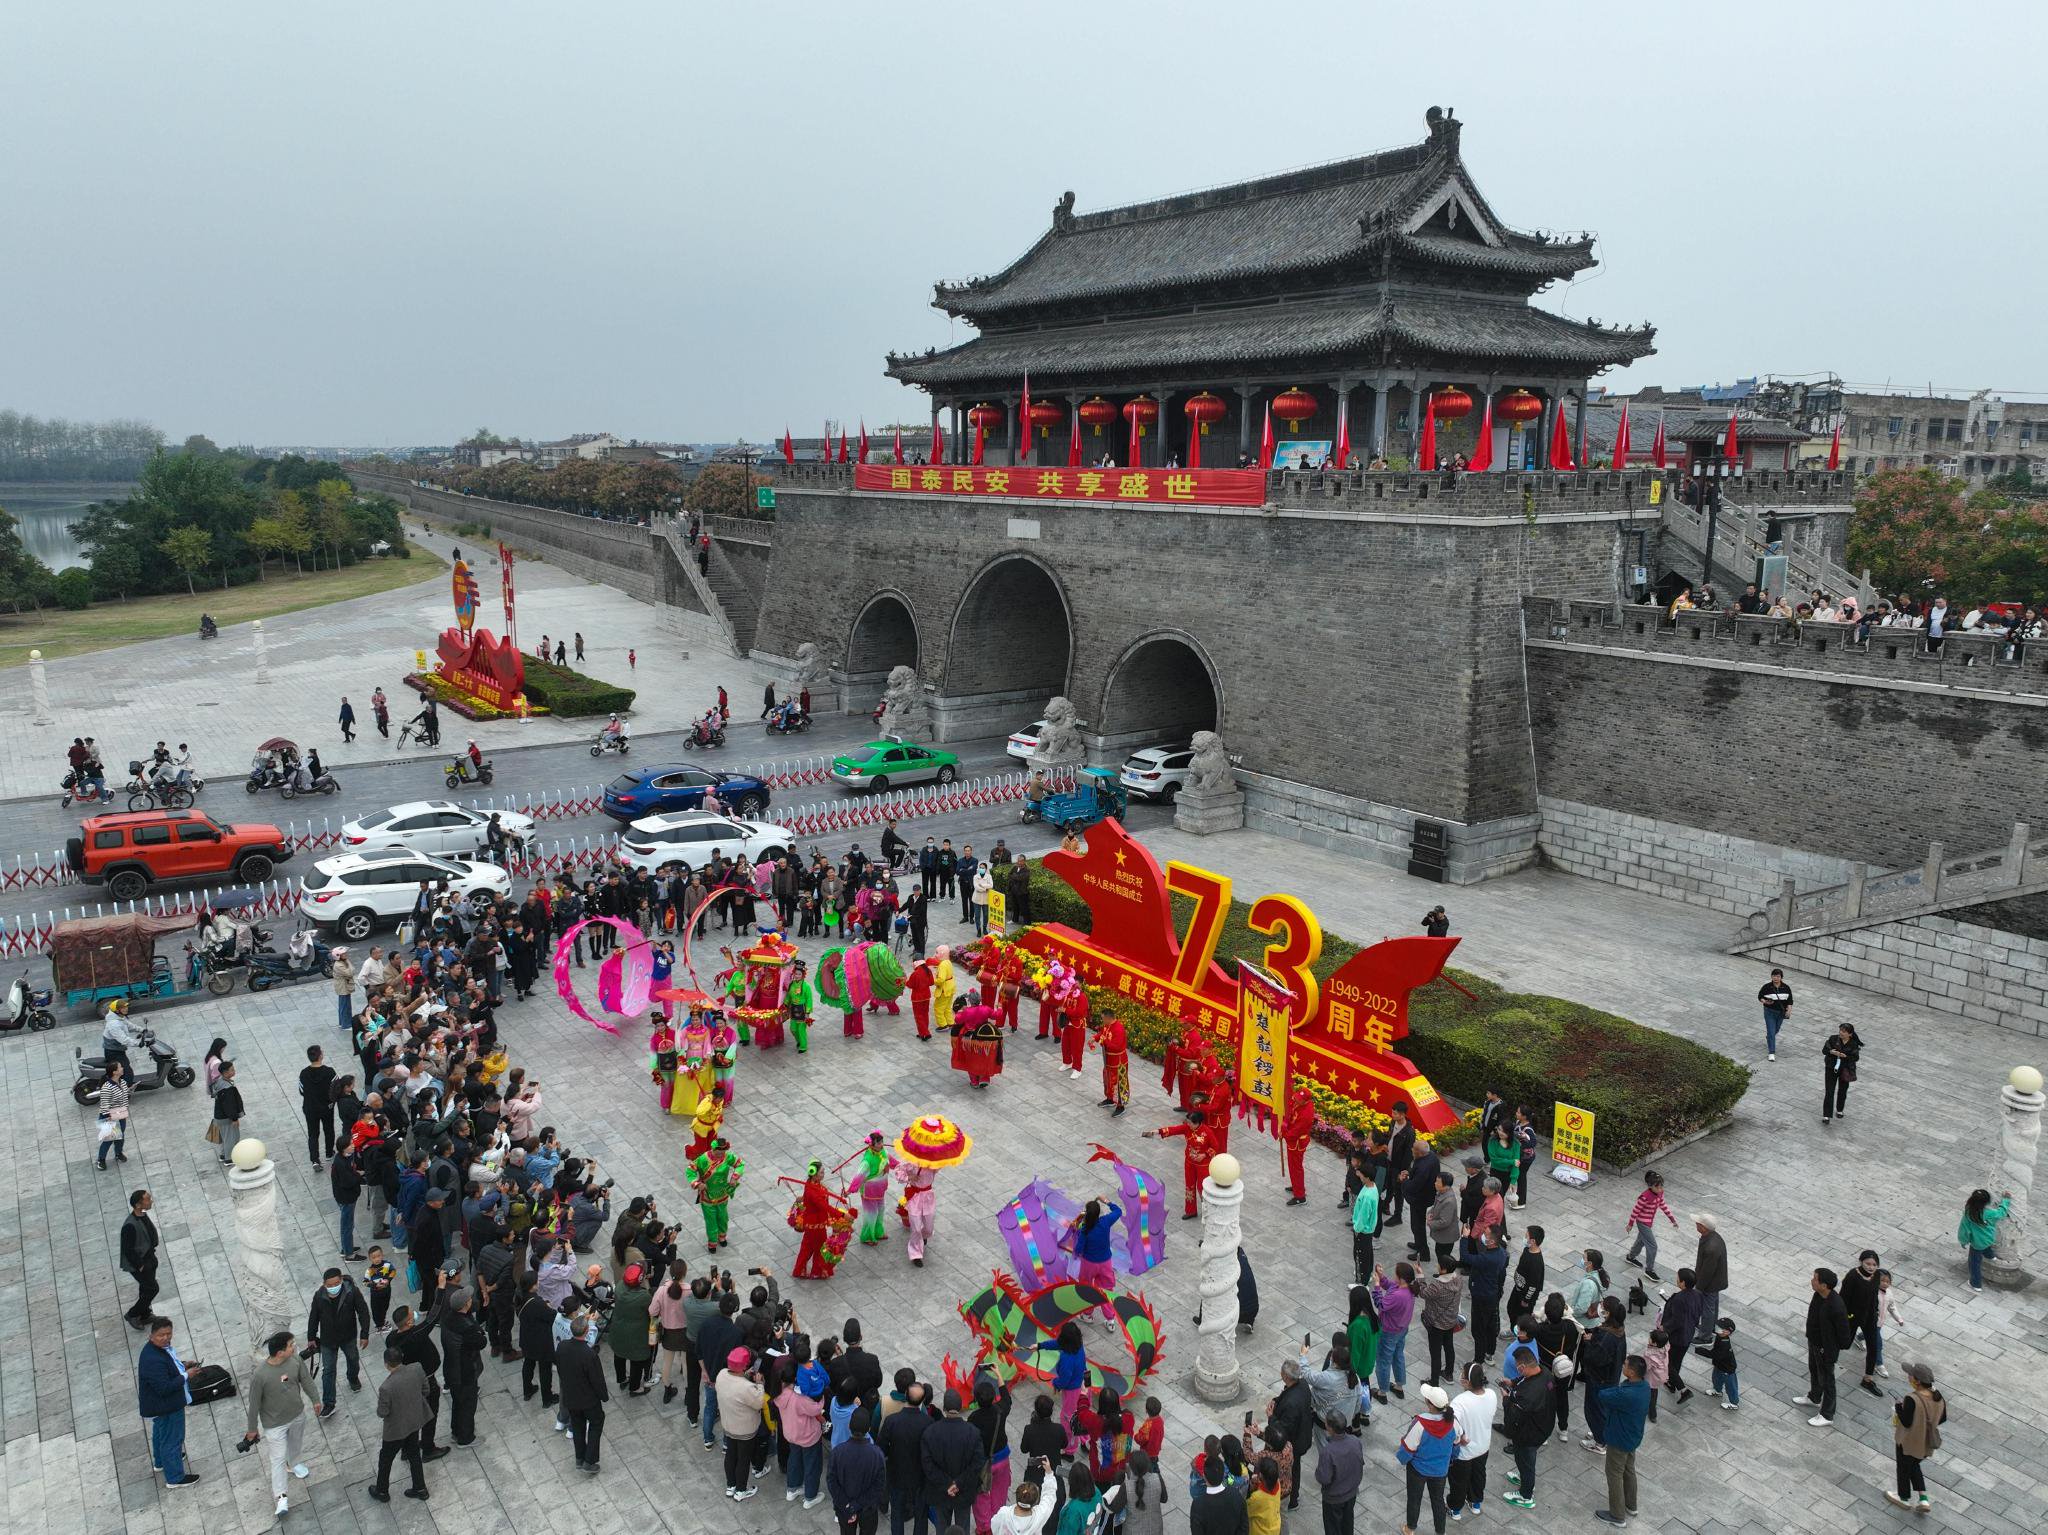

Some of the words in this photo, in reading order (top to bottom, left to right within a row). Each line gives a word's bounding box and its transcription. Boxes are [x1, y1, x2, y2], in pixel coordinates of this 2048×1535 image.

[891, 469, 1009, 493] 国泰民安
[1037, 472, 1198, 499] 共享盛世
[1083, 873, 1143, 903] 中华人民共和国成立
[1115, 869, 1143, 888] 热烈庆祝
[1165, 860, 1322, 1029] 73
[1118, 974, 1183, 1016] 盛世华诞
[1328, 978, 1397, 1018] 1949-2022
[1326, 1000, 1394, 1055] 周年
